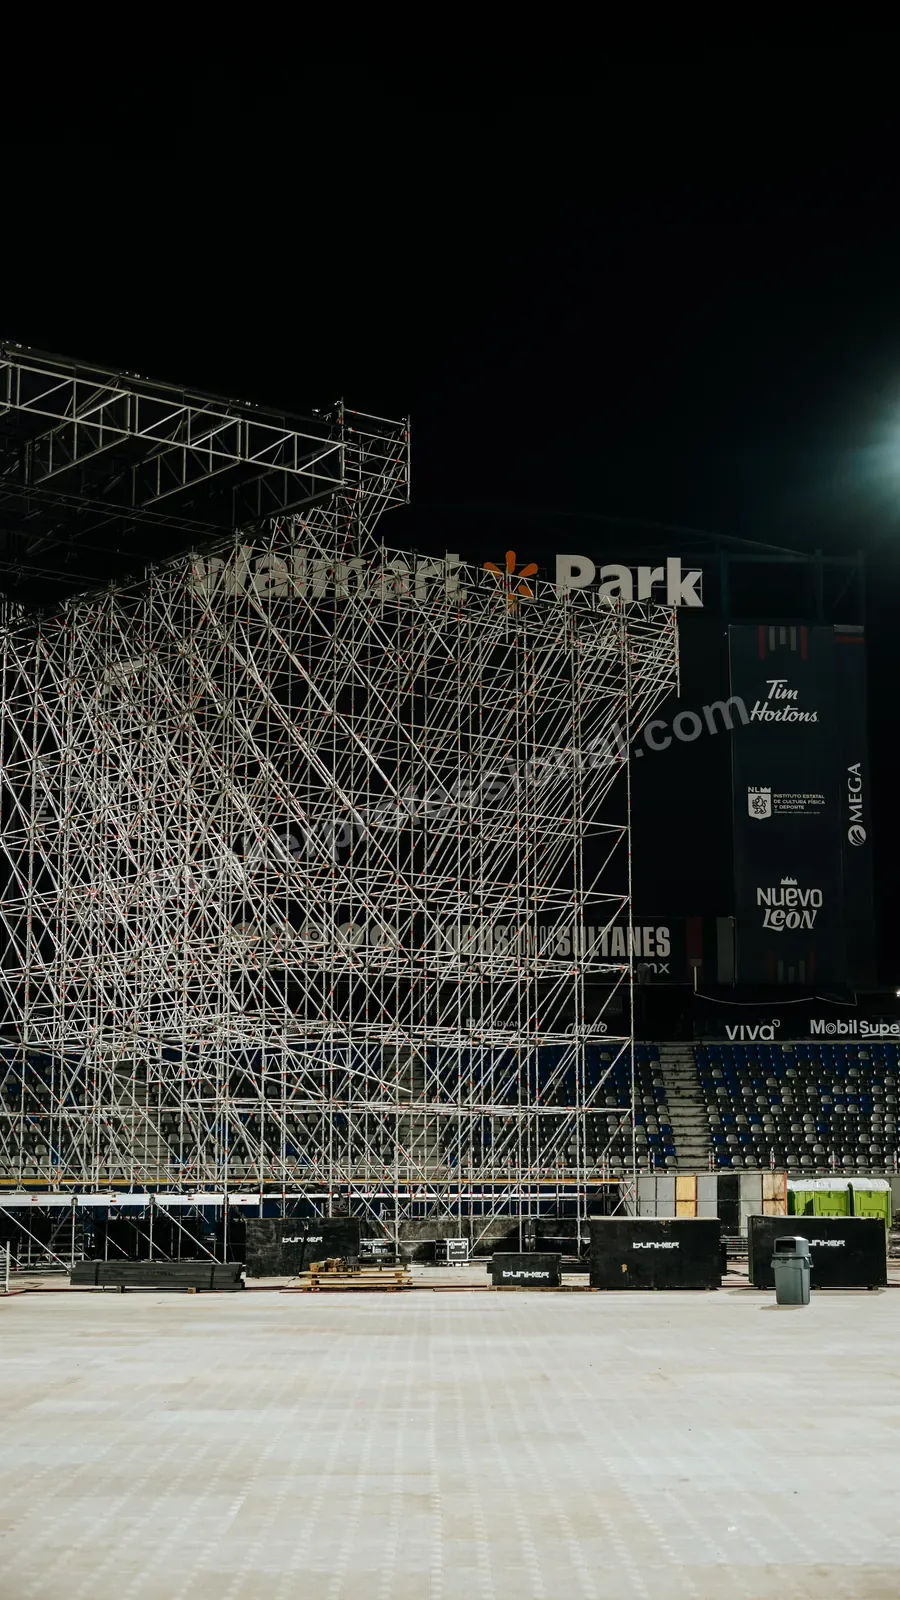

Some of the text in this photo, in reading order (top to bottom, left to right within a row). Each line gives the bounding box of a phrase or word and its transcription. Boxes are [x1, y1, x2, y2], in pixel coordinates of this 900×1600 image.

[556, 554, 704, 609] Park
[766, 679, 798, 700] Tim
[750, 700, 819, 723] Hortons
[810, 1019, 857, 1034] Mobil
